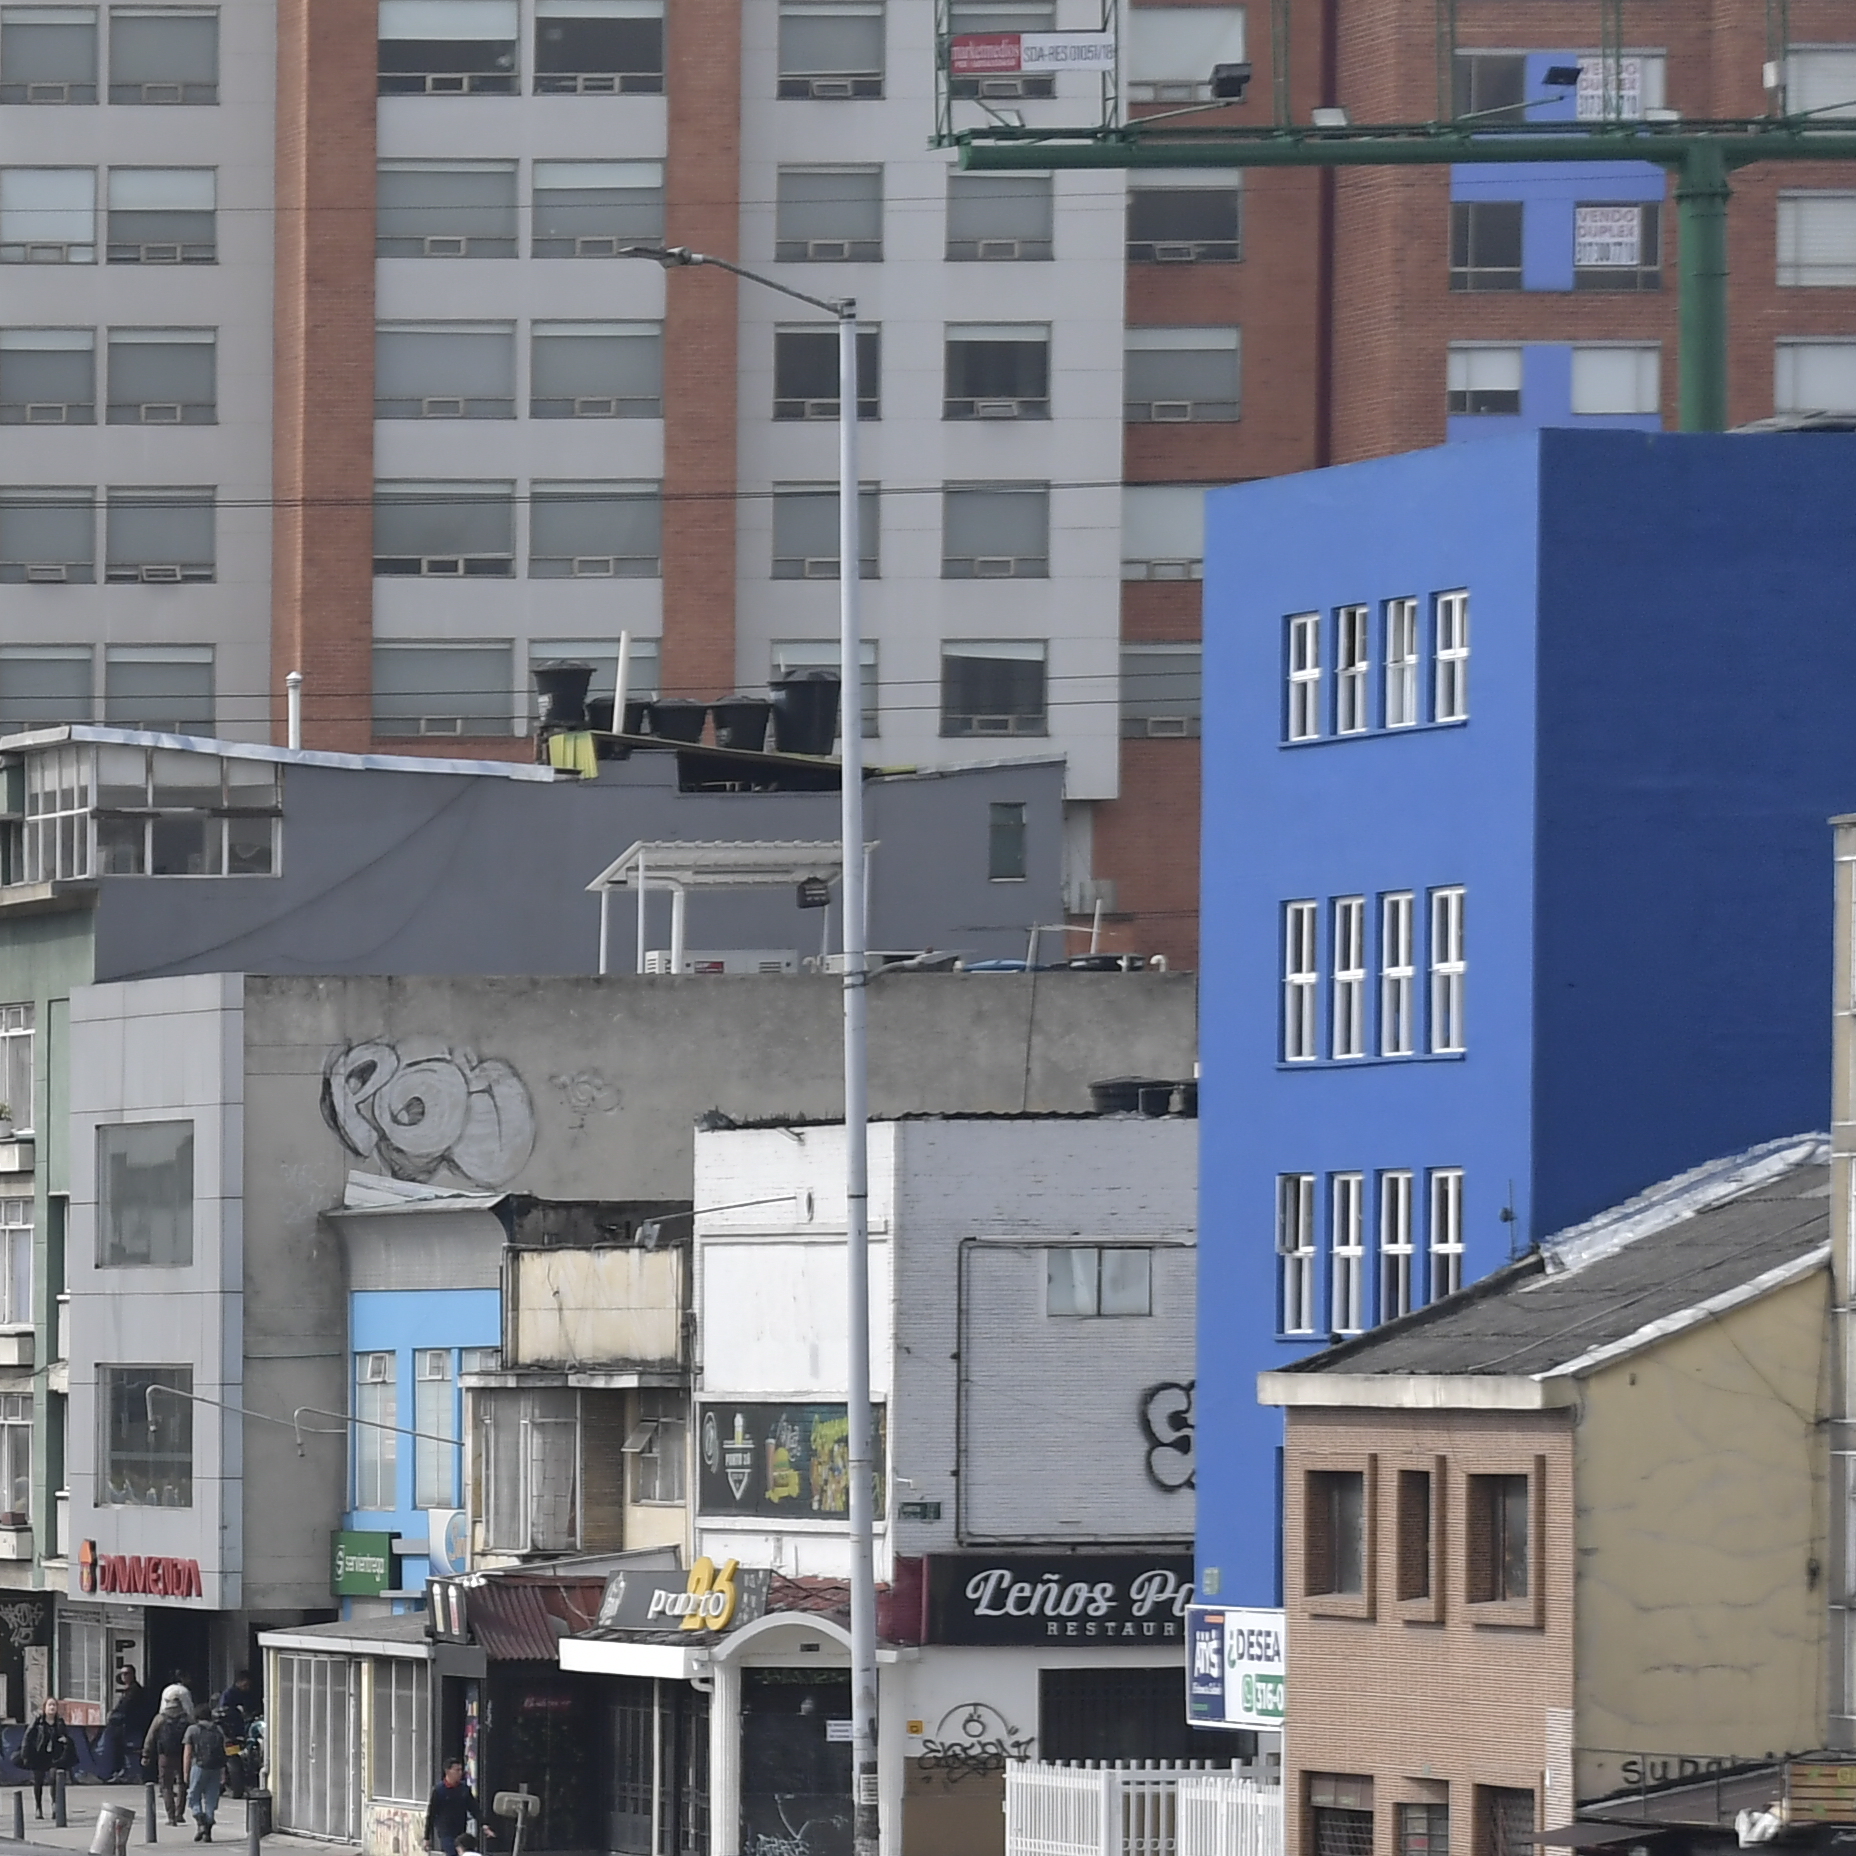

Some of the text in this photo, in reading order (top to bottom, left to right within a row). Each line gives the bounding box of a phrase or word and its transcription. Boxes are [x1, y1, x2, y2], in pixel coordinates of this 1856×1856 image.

[345, 1553, 385, 1582] servientrega
[647, 1588, 727, 1620] punto
[679, 1556, 740, 1631] 26
[965, 1568, 1119, 1618] Leños
[1046, 1621, 1185, 1636] RESTAUR
